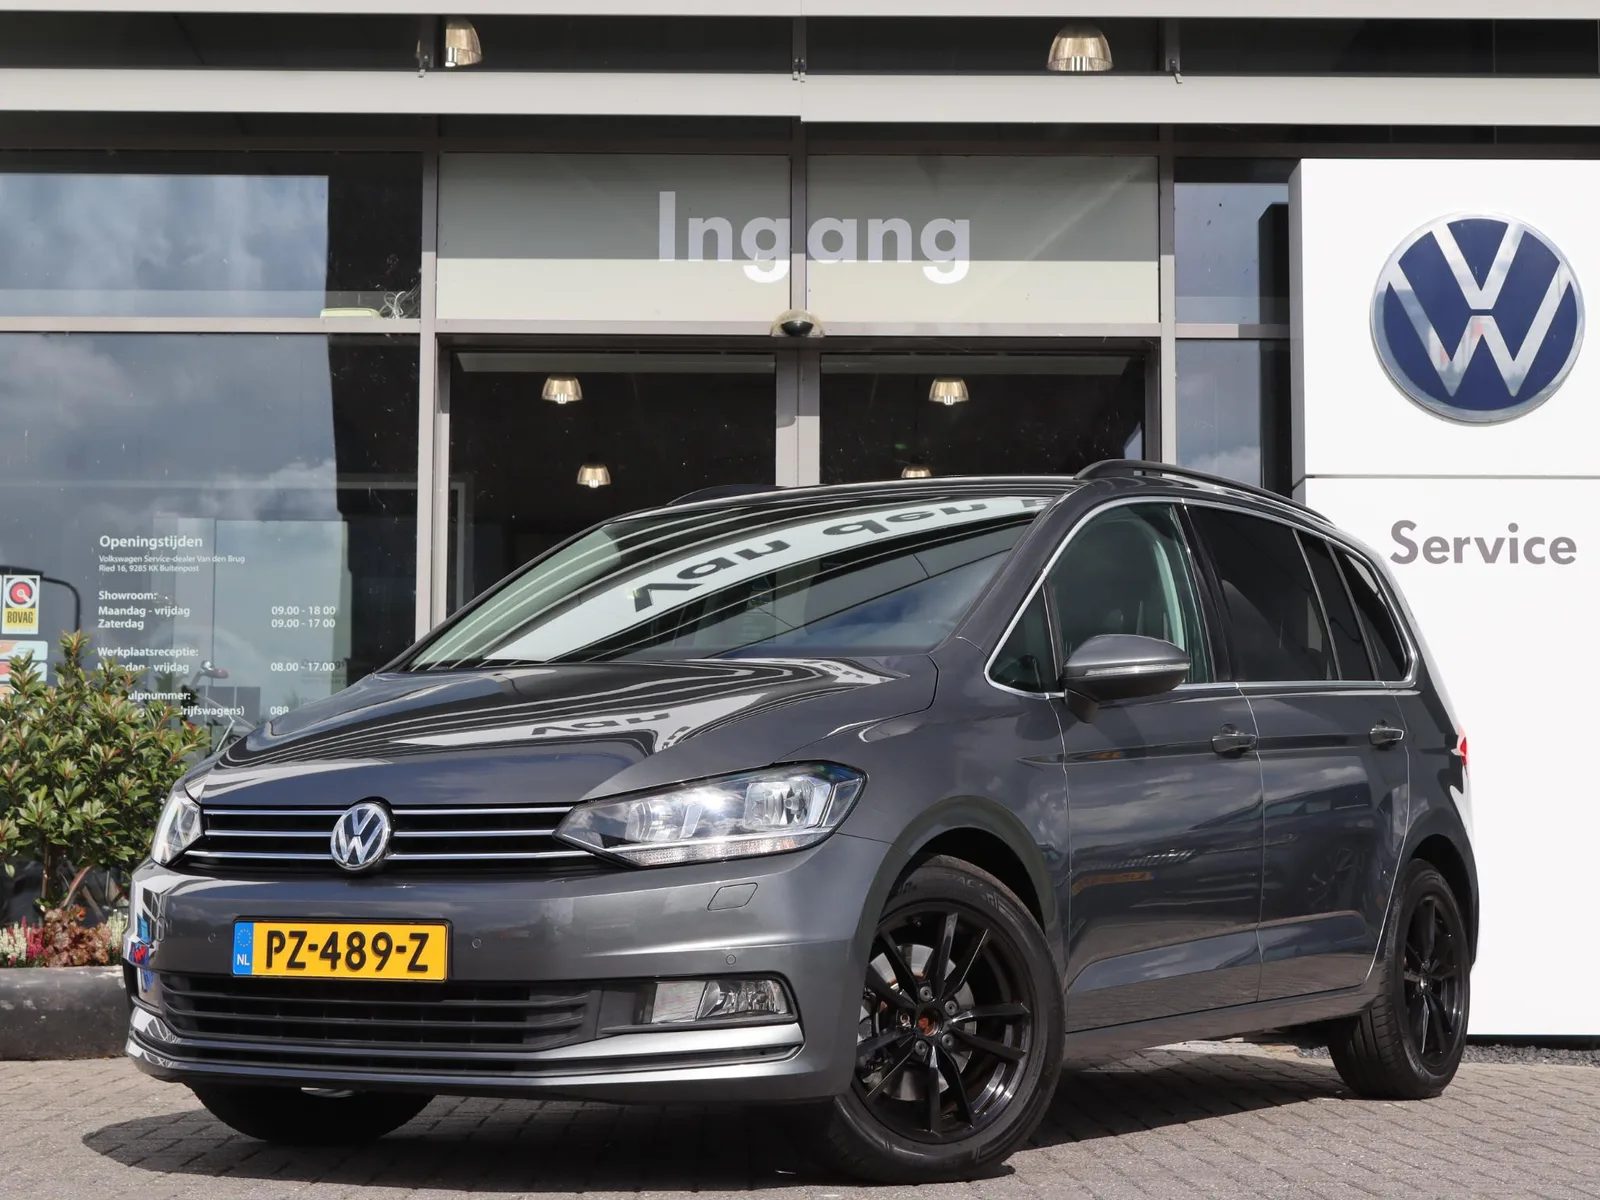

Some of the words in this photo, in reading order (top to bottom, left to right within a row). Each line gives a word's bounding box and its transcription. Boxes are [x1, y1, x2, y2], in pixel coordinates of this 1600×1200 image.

[658, 190, 971, 285] Ingang
[99, 535, 203, 551] Openingstijden
[1390, 520, 1578, 565] Service
[98, 555, 143, 564] Volkswagen
[144, 555, 196, 564] Service-dealer
[197, 555, 211, 563] Van
[212, 555, 227, 563] den
[228, 555, 246, 564] Brug
[98, 564, 115, 572] Ried
[117, 564, 128, 574] 16,
[129, 564, 147, 572] 9285
[149, 564, 159, 572] KK
[160, 564, 200, 574] Buitenpost
[98, 590, 157, 600] Showroom:
[98, 606, 146, 618] Maandag
[154, 606, 191, 618] vrijdag
[271, 605, 300, 616] 09.00
[6, 610, 34, 624] BOVAG
[271, 618, 300, 628] 09.00
[97, 618, 145, 631] Zaterdag
[97, 646, 199, 659] Werkplaatsreceptie:
[154, 662, 190, 674] vrijdag
[270, 662, 299, 672] 08.00
[307, 662, 336, 672] 17.00
[127, 690, 191, 702] ulpnummer:
[180, 705, 245, 718] rijfswagens)
[236, 953, 250, 967] NL
[265, 929, 430, 973] PZ-489-Z
